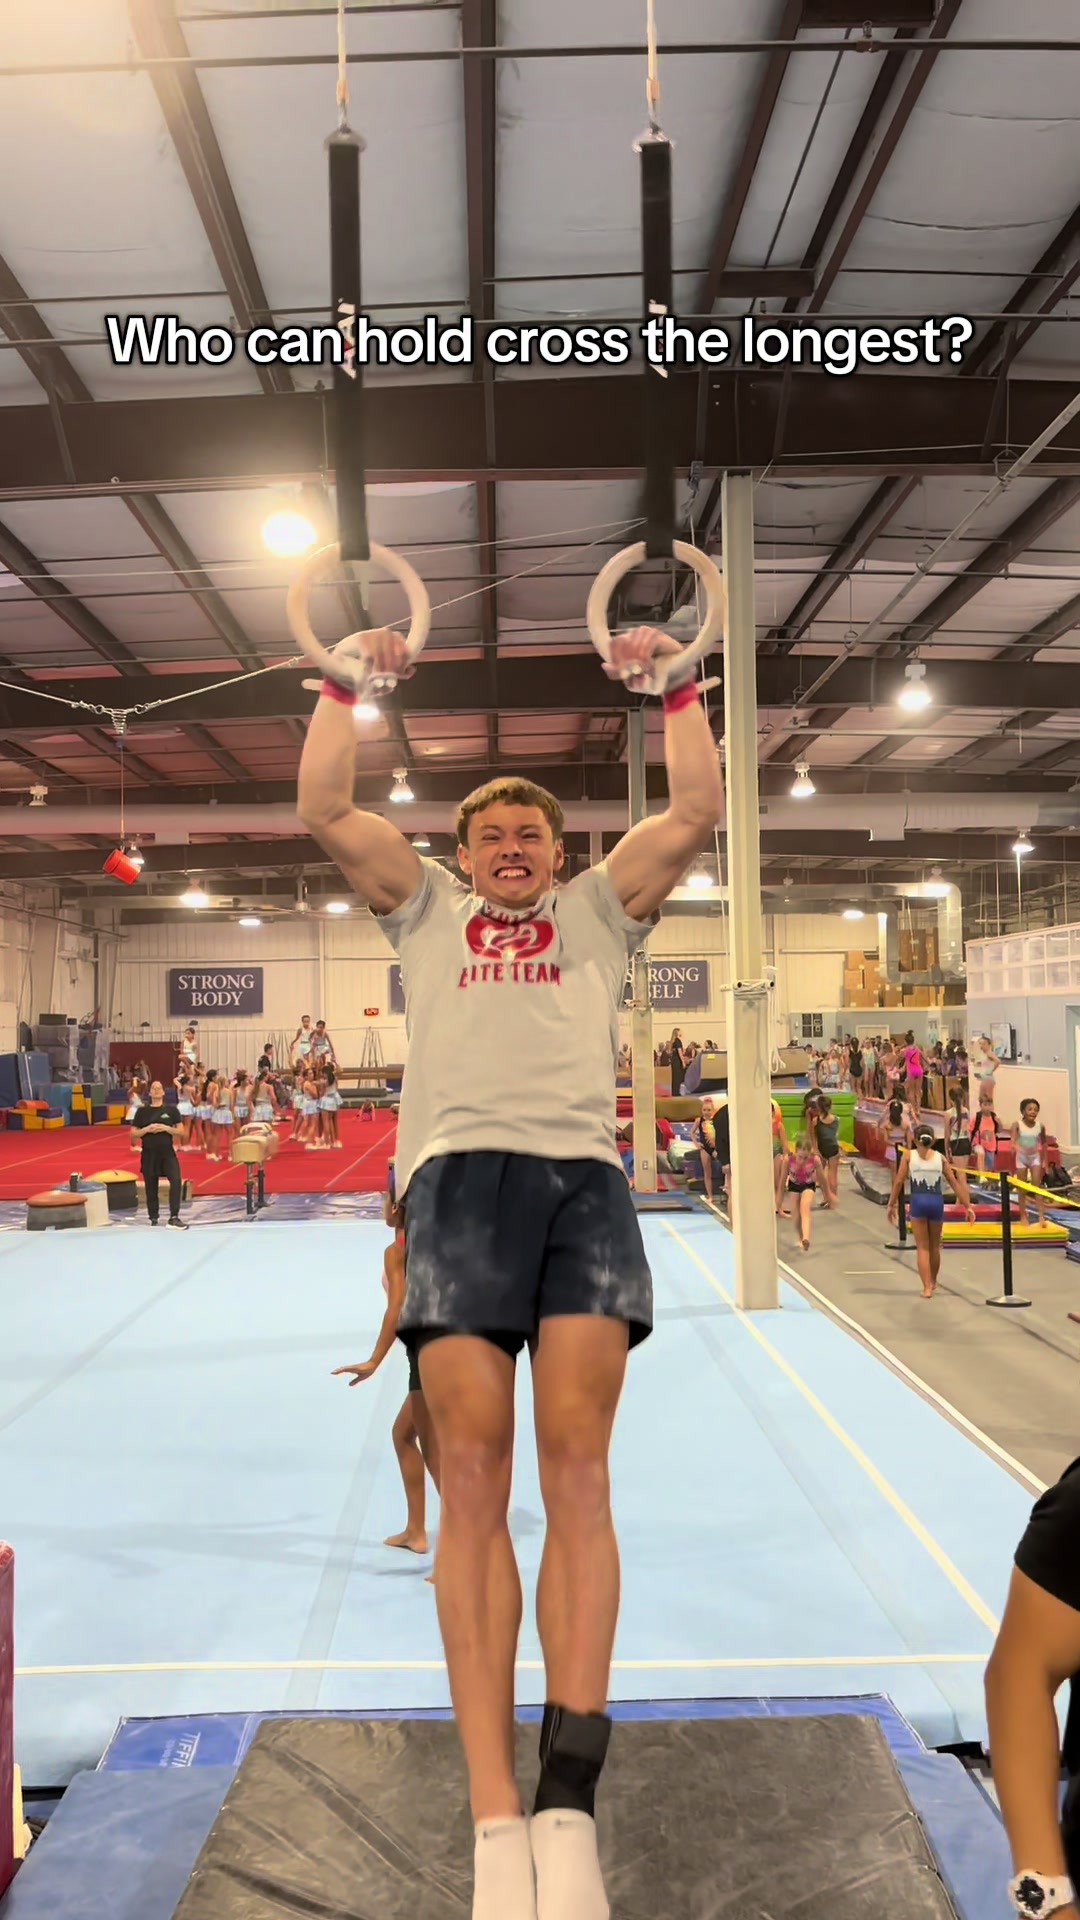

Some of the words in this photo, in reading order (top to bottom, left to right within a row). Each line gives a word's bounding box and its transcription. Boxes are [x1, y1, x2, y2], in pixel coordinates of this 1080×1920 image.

[510, 961, 561, 985] TEAM
[625, 967, 699, 983] SRONG
[178, 974, 255, 989] STRONG
[191, 991, 243, 1006] BODY
[649, 984, 684, 999] ELF
